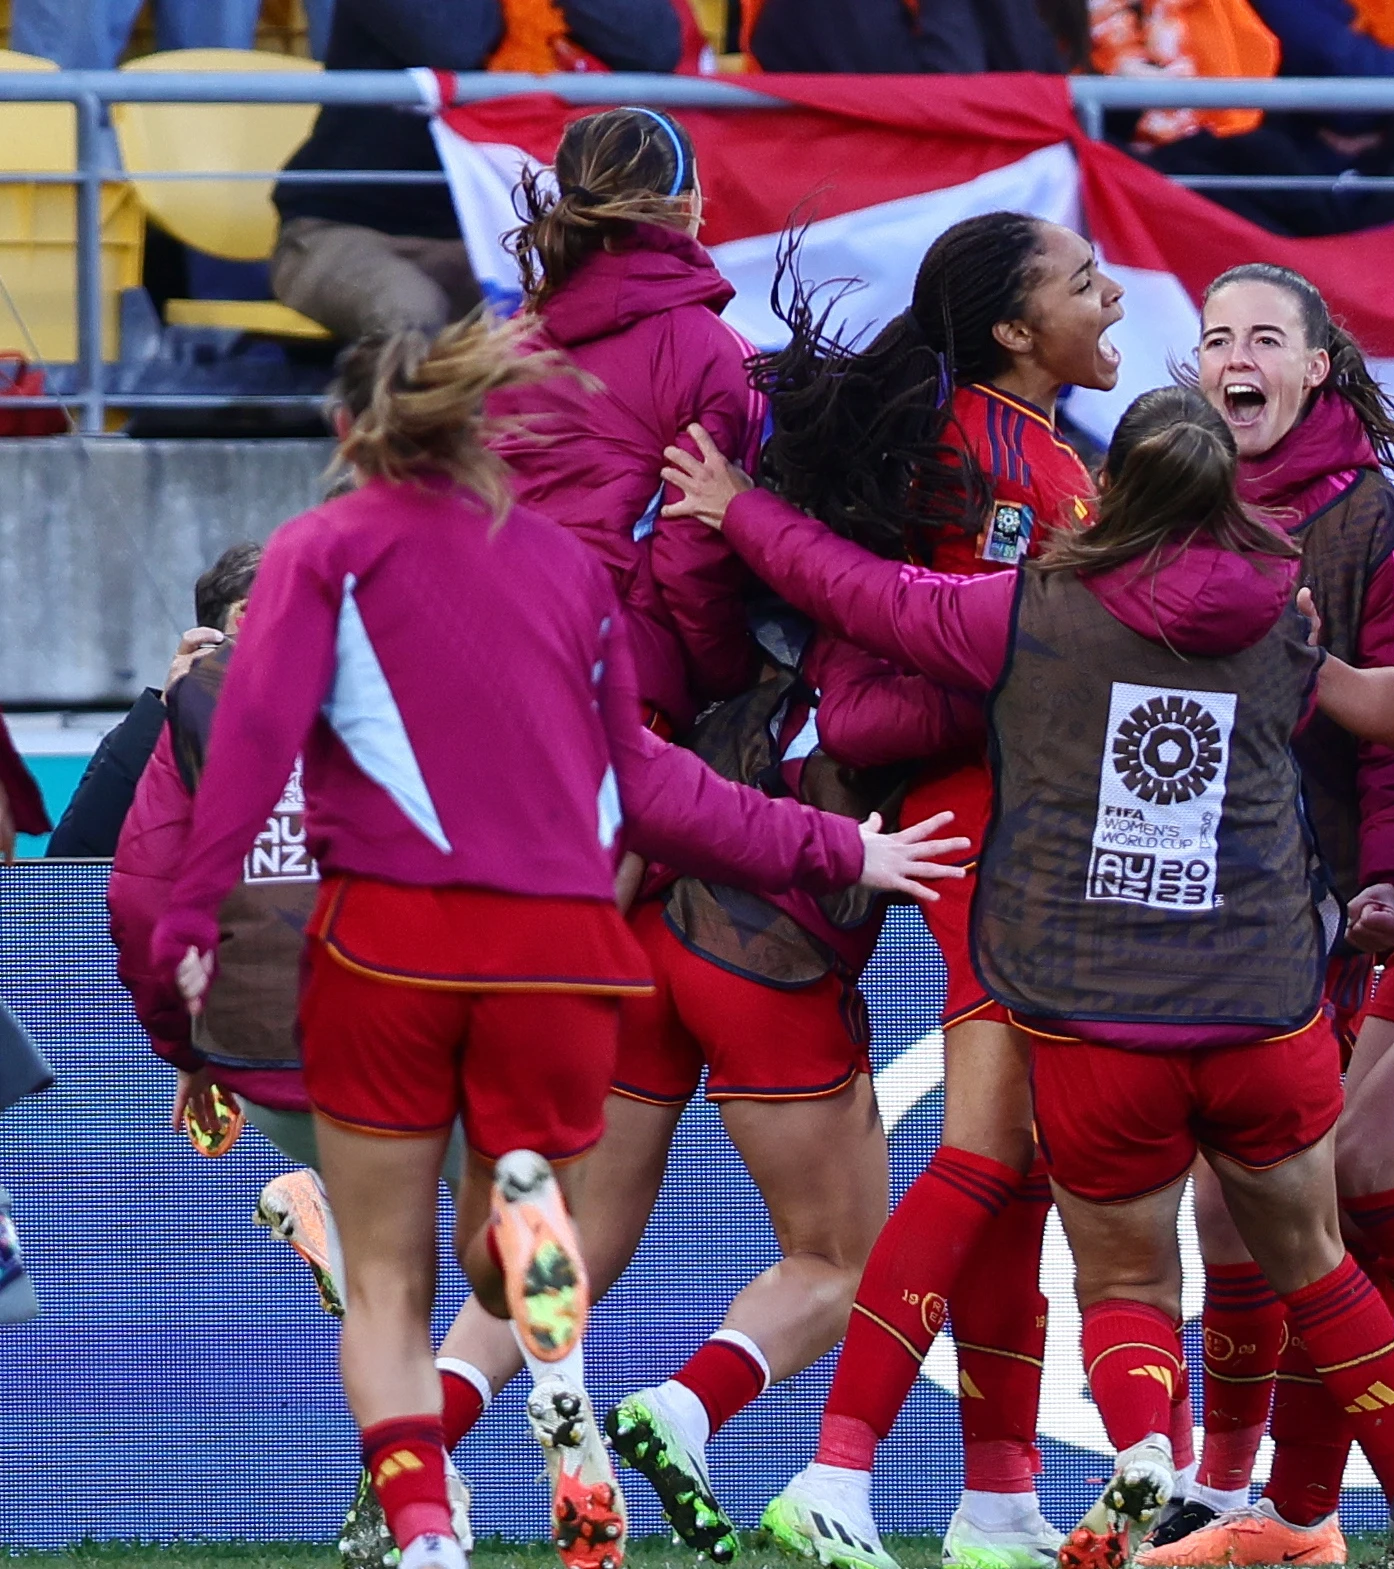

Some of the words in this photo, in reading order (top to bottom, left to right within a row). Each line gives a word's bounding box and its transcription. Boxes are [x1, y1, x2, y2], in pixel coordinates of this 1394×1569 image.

[1105, 805, 1145, 821] FIFA
[254, 815, 307, 845] AU
[1104, 817, 1181, 838] WOMEN'S
[1102, 830, 1158, 848] WORLD
[1160, 838, 1193, 850] CUP
[253, 844, 307, 874] NZ
[1096, 853, 1151, 880] AU
[1159, 859, 1210, 882] 20
[1094, 878, 1148, 899] NZ
[1156, 883, 1208, 905] 23
[901, 1288, 920, 1306] 19
